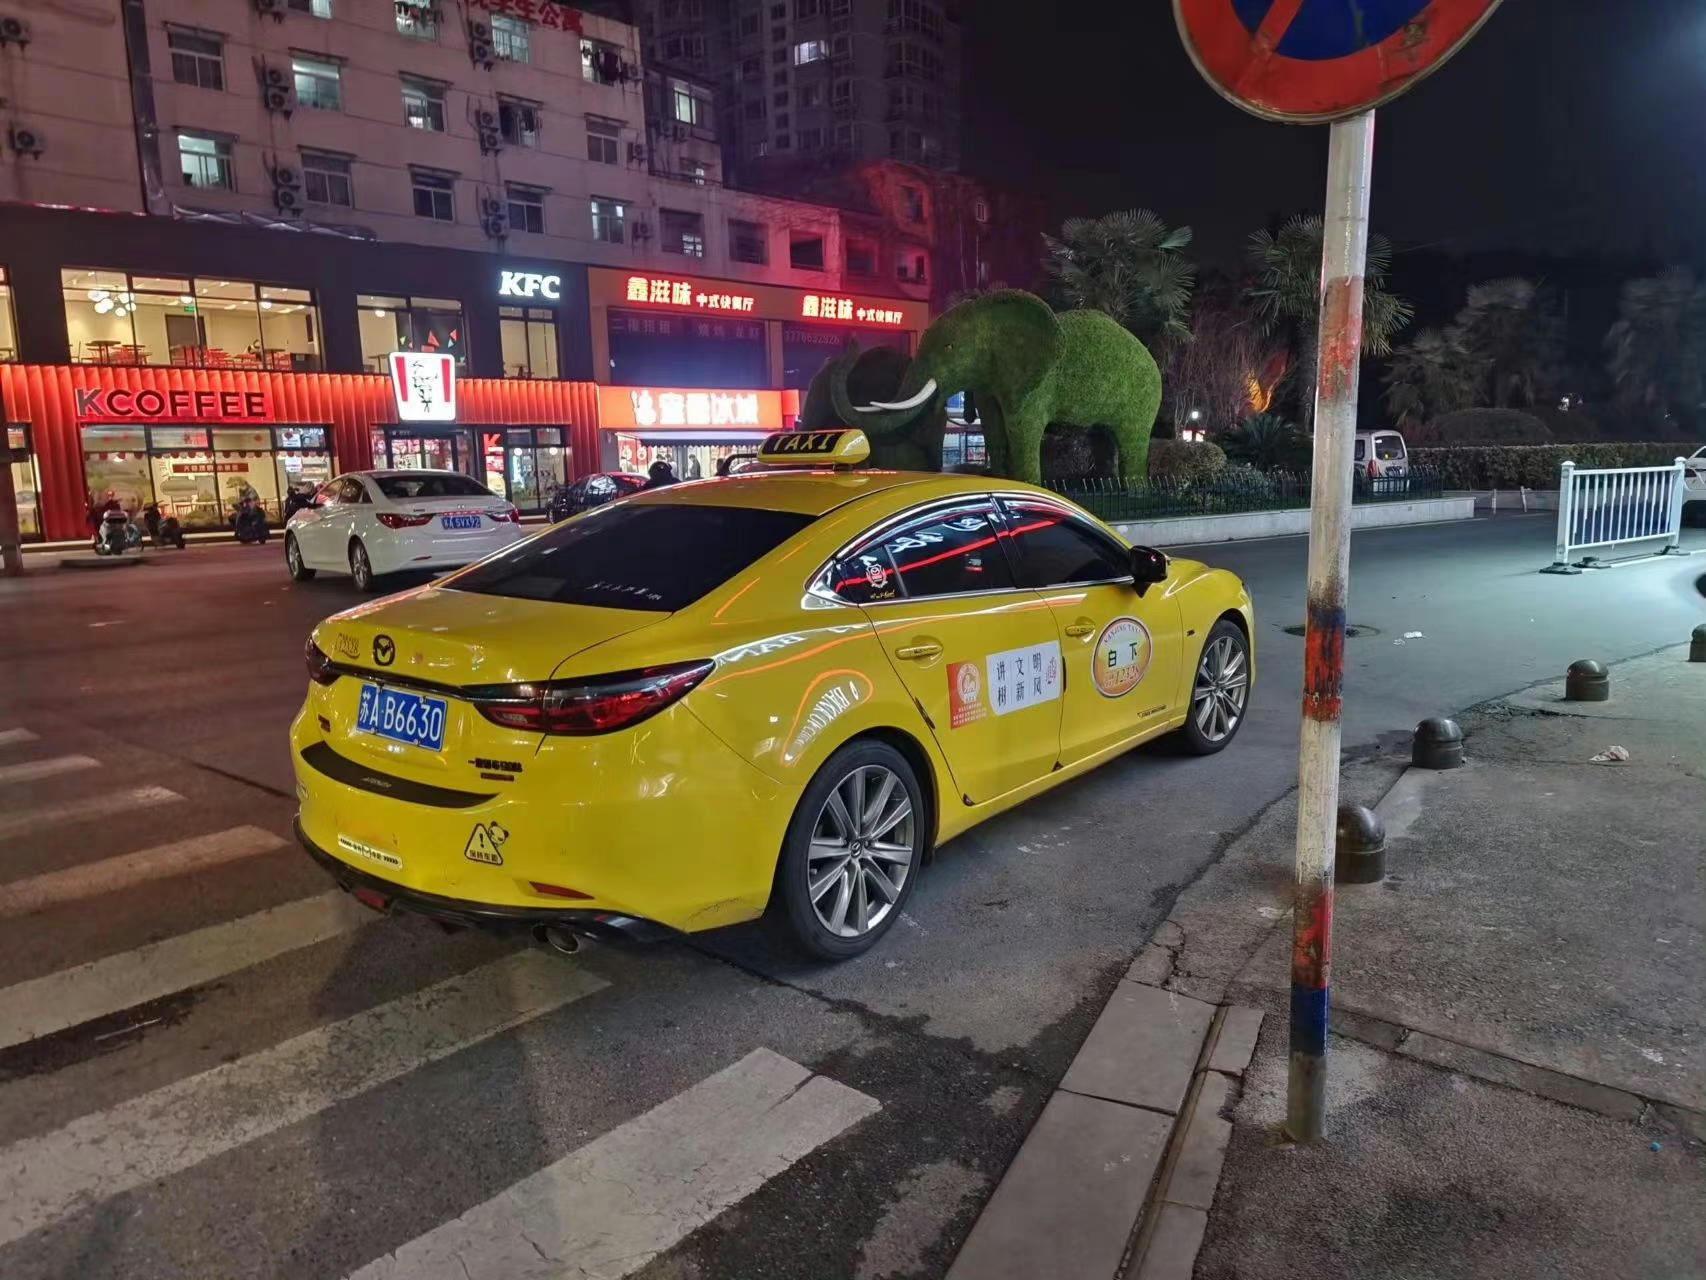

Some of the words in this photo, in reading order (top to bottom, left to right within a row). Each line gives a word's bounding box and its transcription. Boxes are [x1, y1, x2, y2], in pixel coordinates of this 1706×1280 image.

[498, 271, 561, 299] KFC
[626, 276, 692, 306] 鑫滋味
[695, 292, 755, 312] 中式快餐厅
[801, 294, 854, 320] 鑫滋味
[856, 306, 904, 325] 中式快餐厅
[75, 388, 267, 417] KCOFFEE
[772, 433, 835, 452] TAXI
